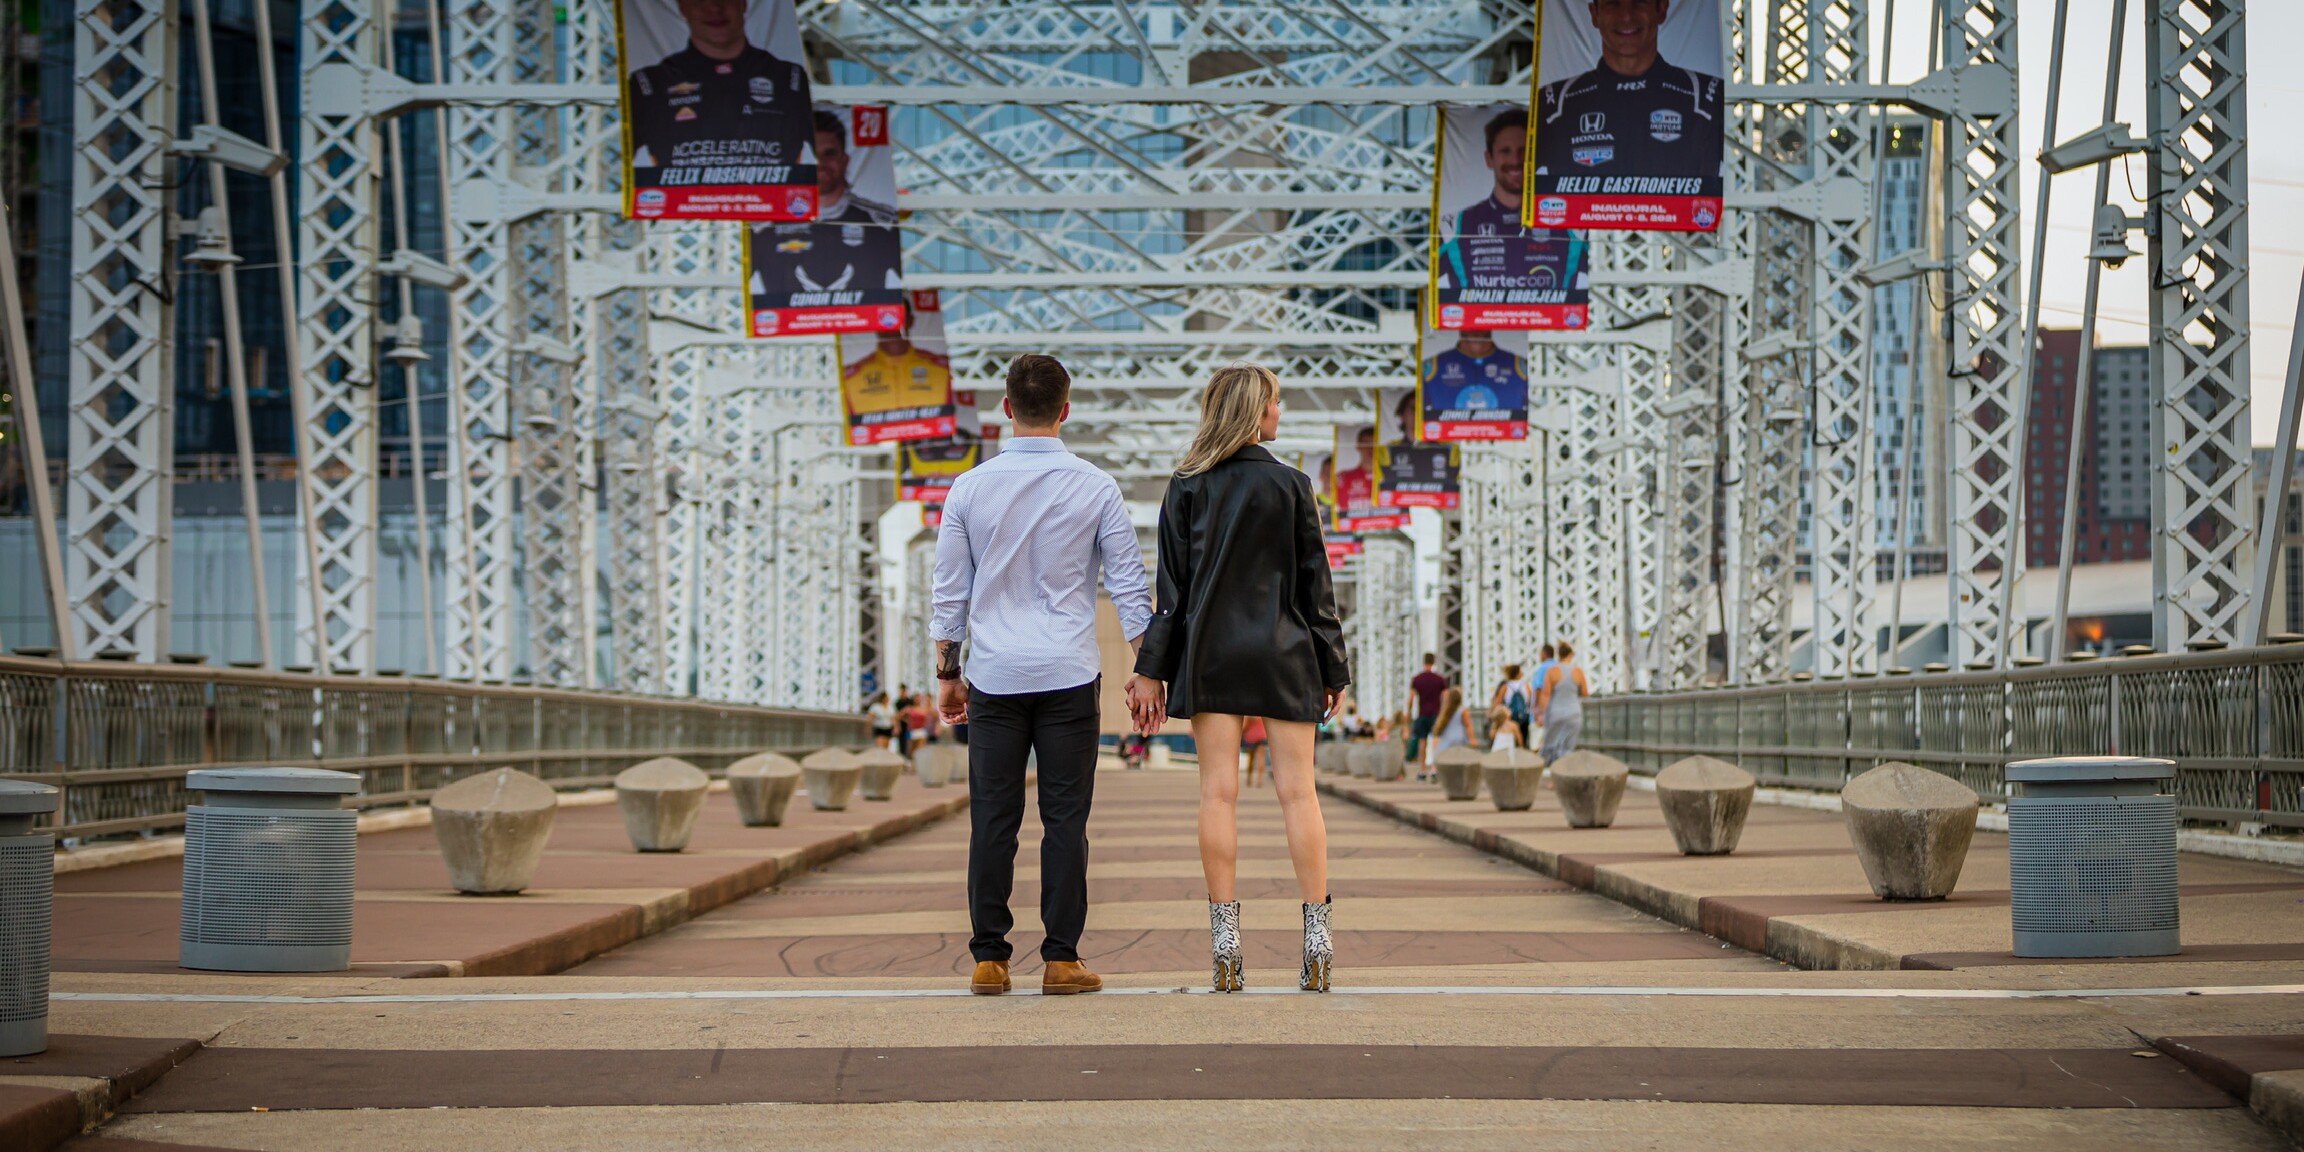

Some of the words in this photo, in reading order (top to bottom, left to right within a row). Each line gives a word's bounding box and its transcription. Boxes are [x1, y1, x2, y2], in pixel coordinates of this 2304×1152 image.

[859, 112, 882, 139] 20
[1571, 133, 1614, 144] HONDA
[672, 140, 782, 157] ACCELERATING
[660, 166, 702, 185] FELIX
[702, 165, 791, 185] ROSENQVIST
[1556, 176, 1601, 193] HELIO
[1602, 177, 1702, 194] CASTRONEVES
[1591, 204, 1666, 213] INAUGURAL
[1580, 213, 1623, 221] AUGUST
[1650, 214, 1677, 222] 2021
[789, 292, 832, 307] CONOR
[832, 290, 864, 305] DALY
[1459, 288, 1506, 303] ROMAIN
[1506, 289, 1568, 303] GROSJEAN
